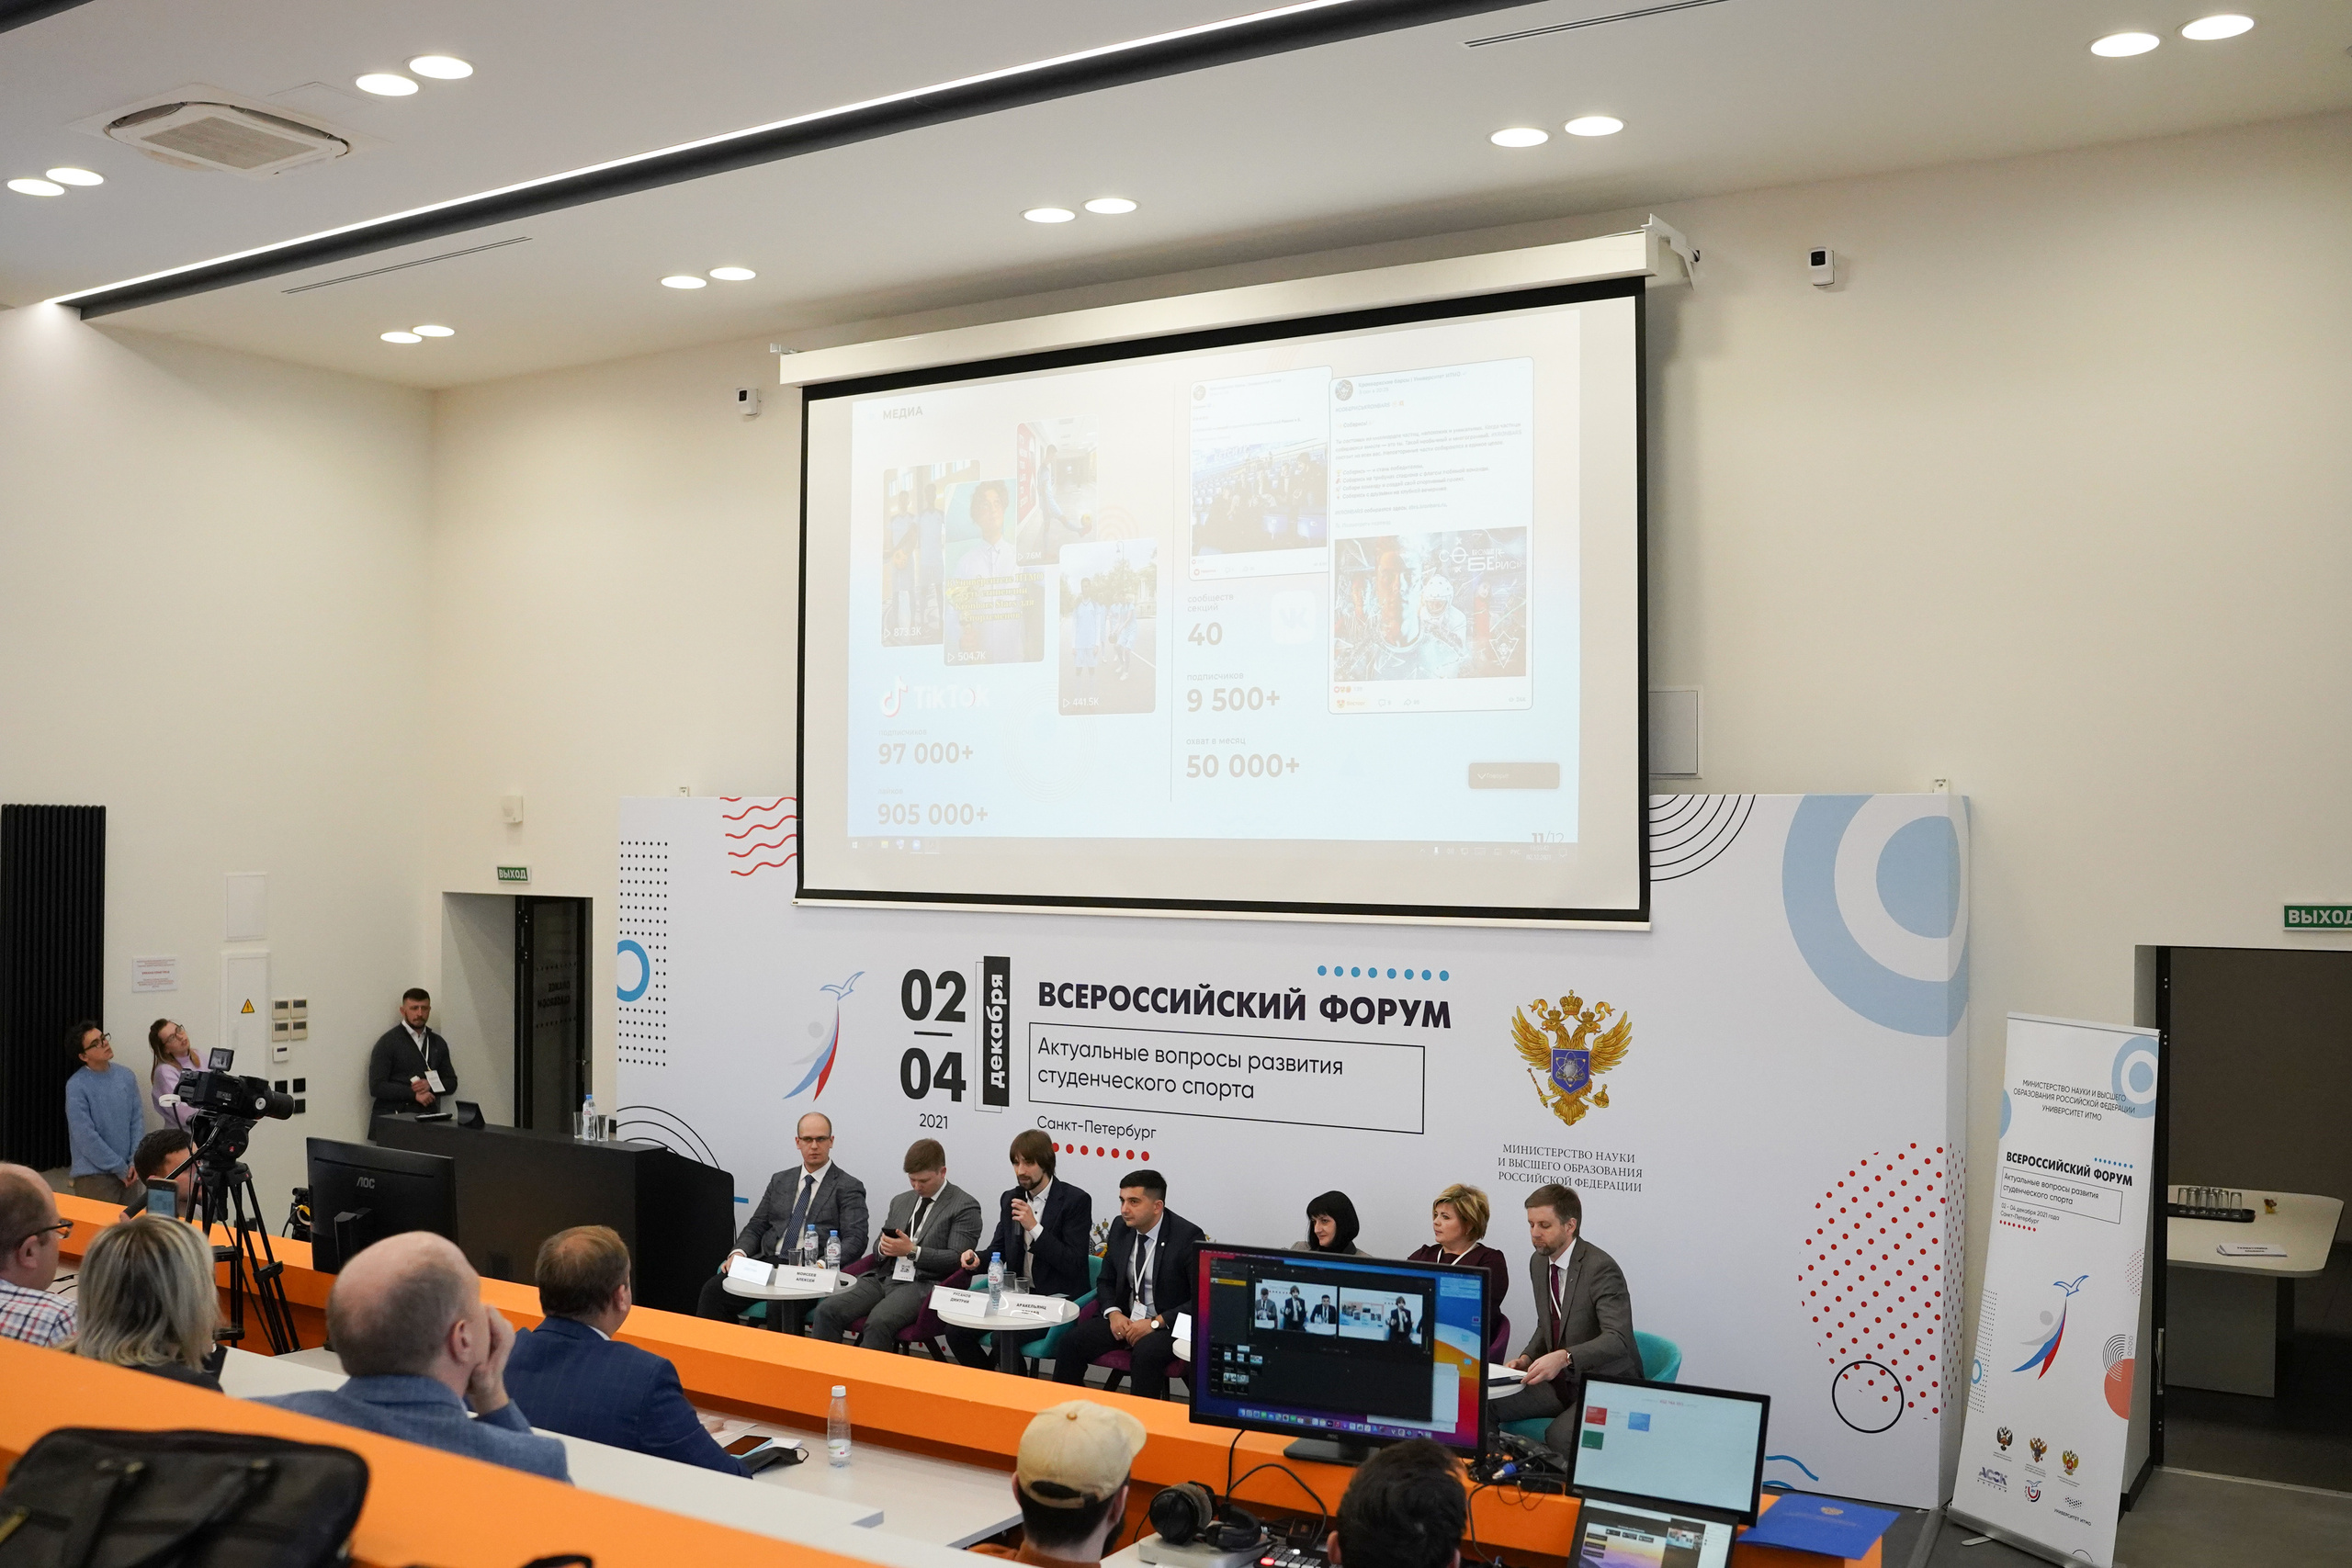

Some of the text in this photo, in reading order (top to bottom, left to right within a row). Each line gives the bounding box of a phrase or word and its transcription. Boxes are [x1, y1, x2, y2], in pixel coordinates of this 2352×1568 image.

[883, 406, 922, 421] МЕДИА
[1187, 593, 1234, 604] сообществ
[1187, 603, 1218, 612] секций
[1187, 621, 1222, 646] 40
[957, 650, 987, 661] 504.7K
[1187, 672, 1244, 682] подписчиков
[1187, 686, 1281, 713] 9 500+
[1186, 737, 1209, 745] охват
[1219, 737, 1246, 746] месяц
[878, 742, 974, 764] 97 000+
[1186, 753, 1299, 779] 50 000+
[878, 803, 989, 825] 905 000+
[499, 869, 526, 879] ВЫХОД
[900, 968, 967, 1023] 02
[1038, 983, 1452, 1029] ВСЕРОССИЙСКИЙ ФОРУМ
[986, 974, 1007, 1089] декабря
[1038, 1036, 1343, 1076] Актуальные вопросы развития
[900, 1047, 967, 1102] 04
[1038, 1068, 1255, 1101] студенческого спорта
[2014, 1089, 2135, 1114] ОБРАЗОВАНИЯ РОССИЙСКОЙ ФЕДЕРАЦИИ
[2022, 1079, 2126, 1102] МИНИСТЕРСТВО НАУКИ И ВЫСШЕГО
[919, 1113, 948, 1130] 2021
[2041, 1104, 2102, 1121] УНИВЕРСИТЕТ ИТМО
[1036, 1115, 1158, 1141] Санкт-Петербург
[1503, 1145, 1635, 1163] МИНИСТЕРСТВО НАУКИ
[1498, 1157, 1643, 1179] И ВЫСШЕГО ОБРАЗОВАНИЯ
[2007, 1151, 2133, 1187] ВСЕРОССИЙСКИЙ ФОРУМ
[356, 1176, 375, 1189] AOC
[1498, 1171, 1643, 1192] РОССИЙСКОЙ ФЕДЕРАЦИИ
[2003, 1172, 2098, 1200] Актуальные вопросы развития
[2003, 1185, 2073, 1206] студенческого спорта
[2000, 1211, 2040, 1224] Санкт-Петербург
